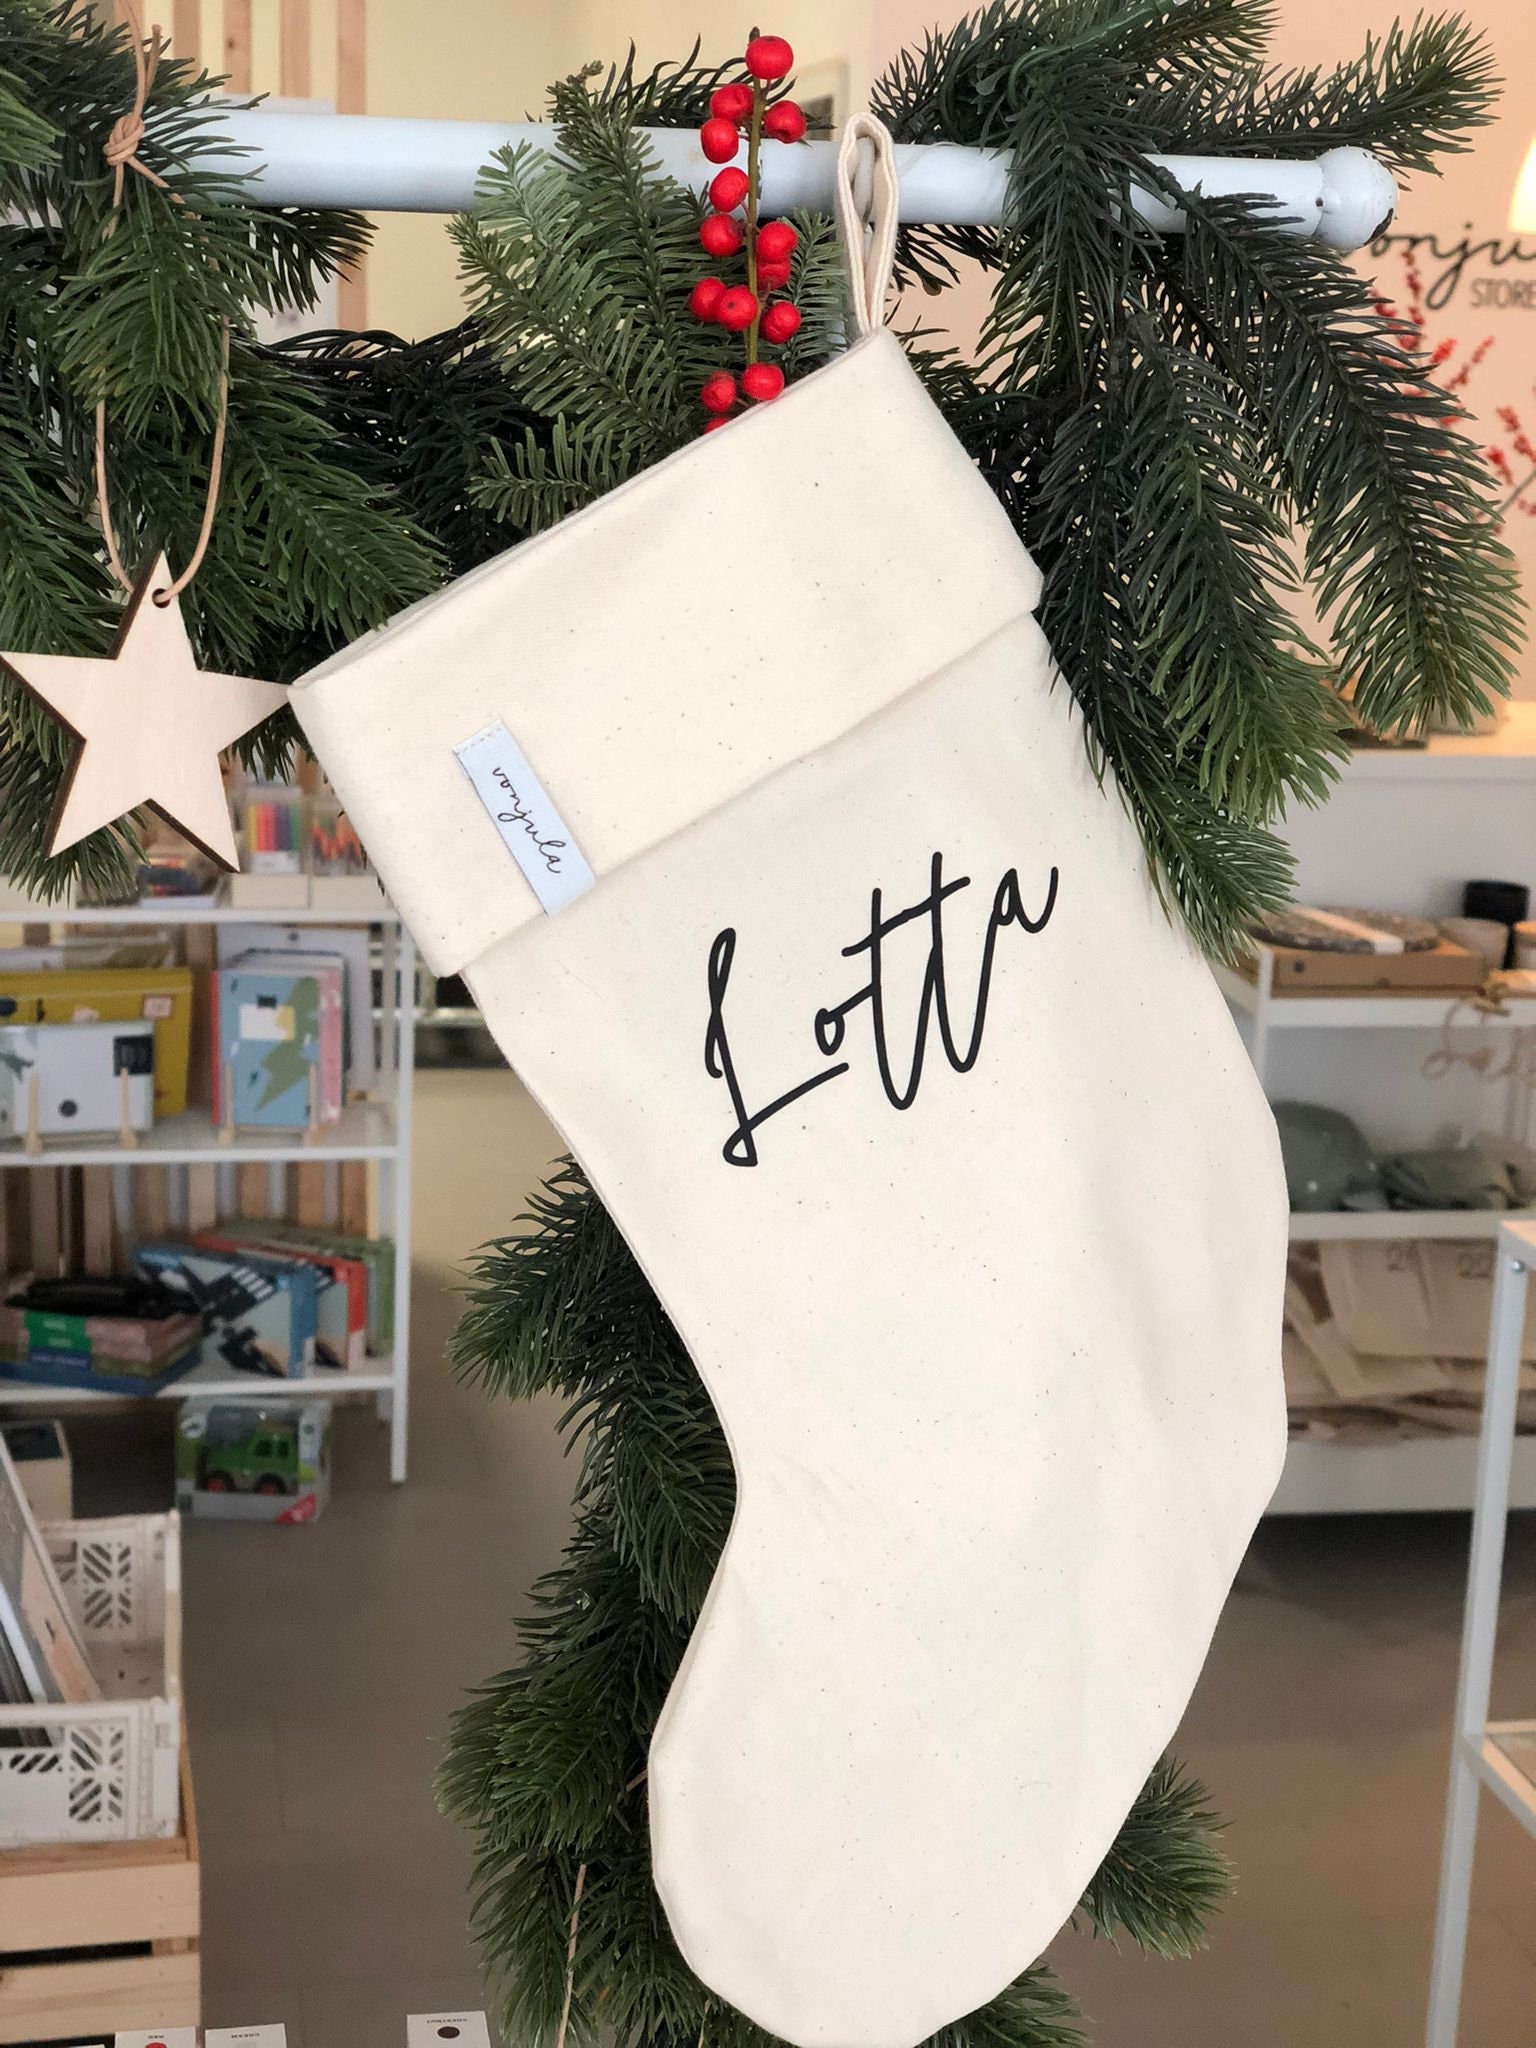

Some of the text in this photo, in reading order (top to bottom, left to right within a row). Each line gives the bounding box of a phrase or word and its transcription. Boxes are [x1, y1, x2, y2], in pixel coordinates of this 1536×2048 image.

[1345, 222, 1536, 310] onju
[1470, 277, 1536, 311] STORE
[492, 767, 566, 874] vonjula
[704, 851, 1059, 1167] Lotta
